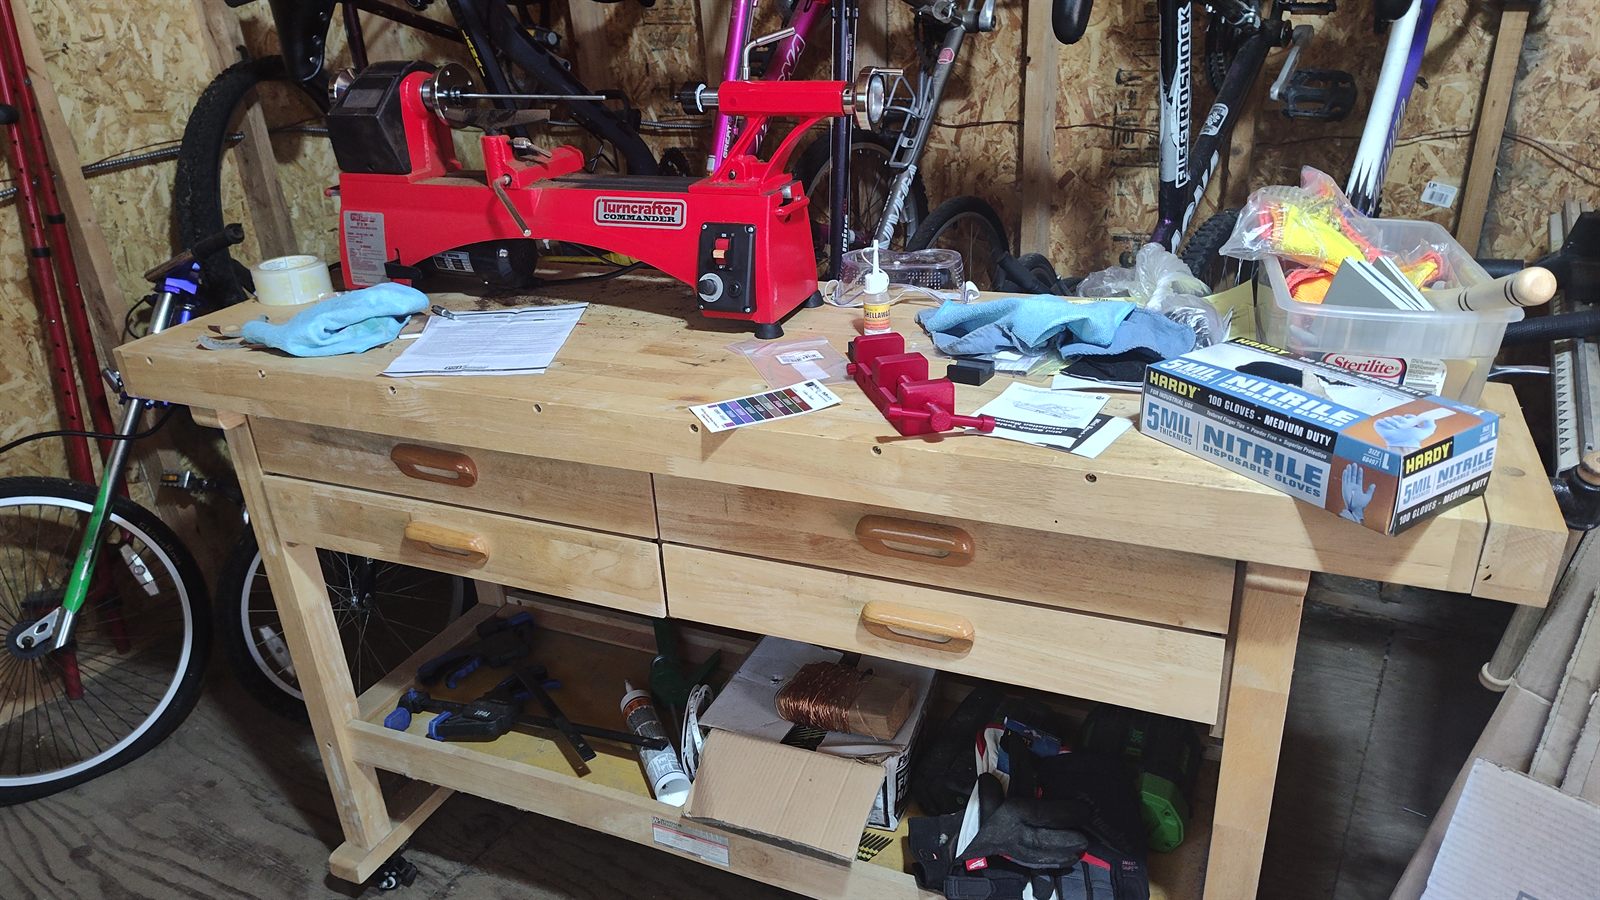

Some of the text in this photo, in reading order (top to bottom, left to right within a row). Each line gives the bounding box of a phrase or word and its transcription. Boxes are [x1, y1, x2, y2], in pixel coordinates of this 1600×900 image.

[601, 199, 678, 216] Turncrafter
[602, 213, 676, 223] COMMANDER
[1236, 338, 1290, 355] HARDY
[1334, 355, 1395, 375] Sterilite
[1150, 371, 1197, 399] HARDY
[1150, 388, 1194, 411] FOR INDUSTRIAL USE
[1223, 373, 1360, 420] NITRILE
[1399, 386, 1427, 396] DUTY
[1219, 382, 1293, 410] DISPOSABLE
[1294, 407, 1345, 428] GLOVES
[1208, 394, 1222, 408] 100
[1224, 400, 1255, 421] GLOVES
[1263, 414, 1304, 438] MEDIUM
[1306, 429, 1332, 447] DUTY
[1235, 420, 1245, 431] Tips
[1303, 446, 1327, 460] Protection
[1368, 447, 1381, 459] SIZE
[1159, 426, 1321, 498] THICKNESS DISPOSABLE GLOVES
[1203, 424, 1324, 489] NITRILE
[1382, 452, 1390, 470] L
[1405, 442, 1449, 475] HARDY
[1437, 447, 1495, 482] NITRILE
[1400, 513, 1411, 526] 100
[1412, 499, 1437, 521] GLOVES
[1442, 484, 1471, 506] MEDIUM
[1471, 476, 1489, 493] DUTY
